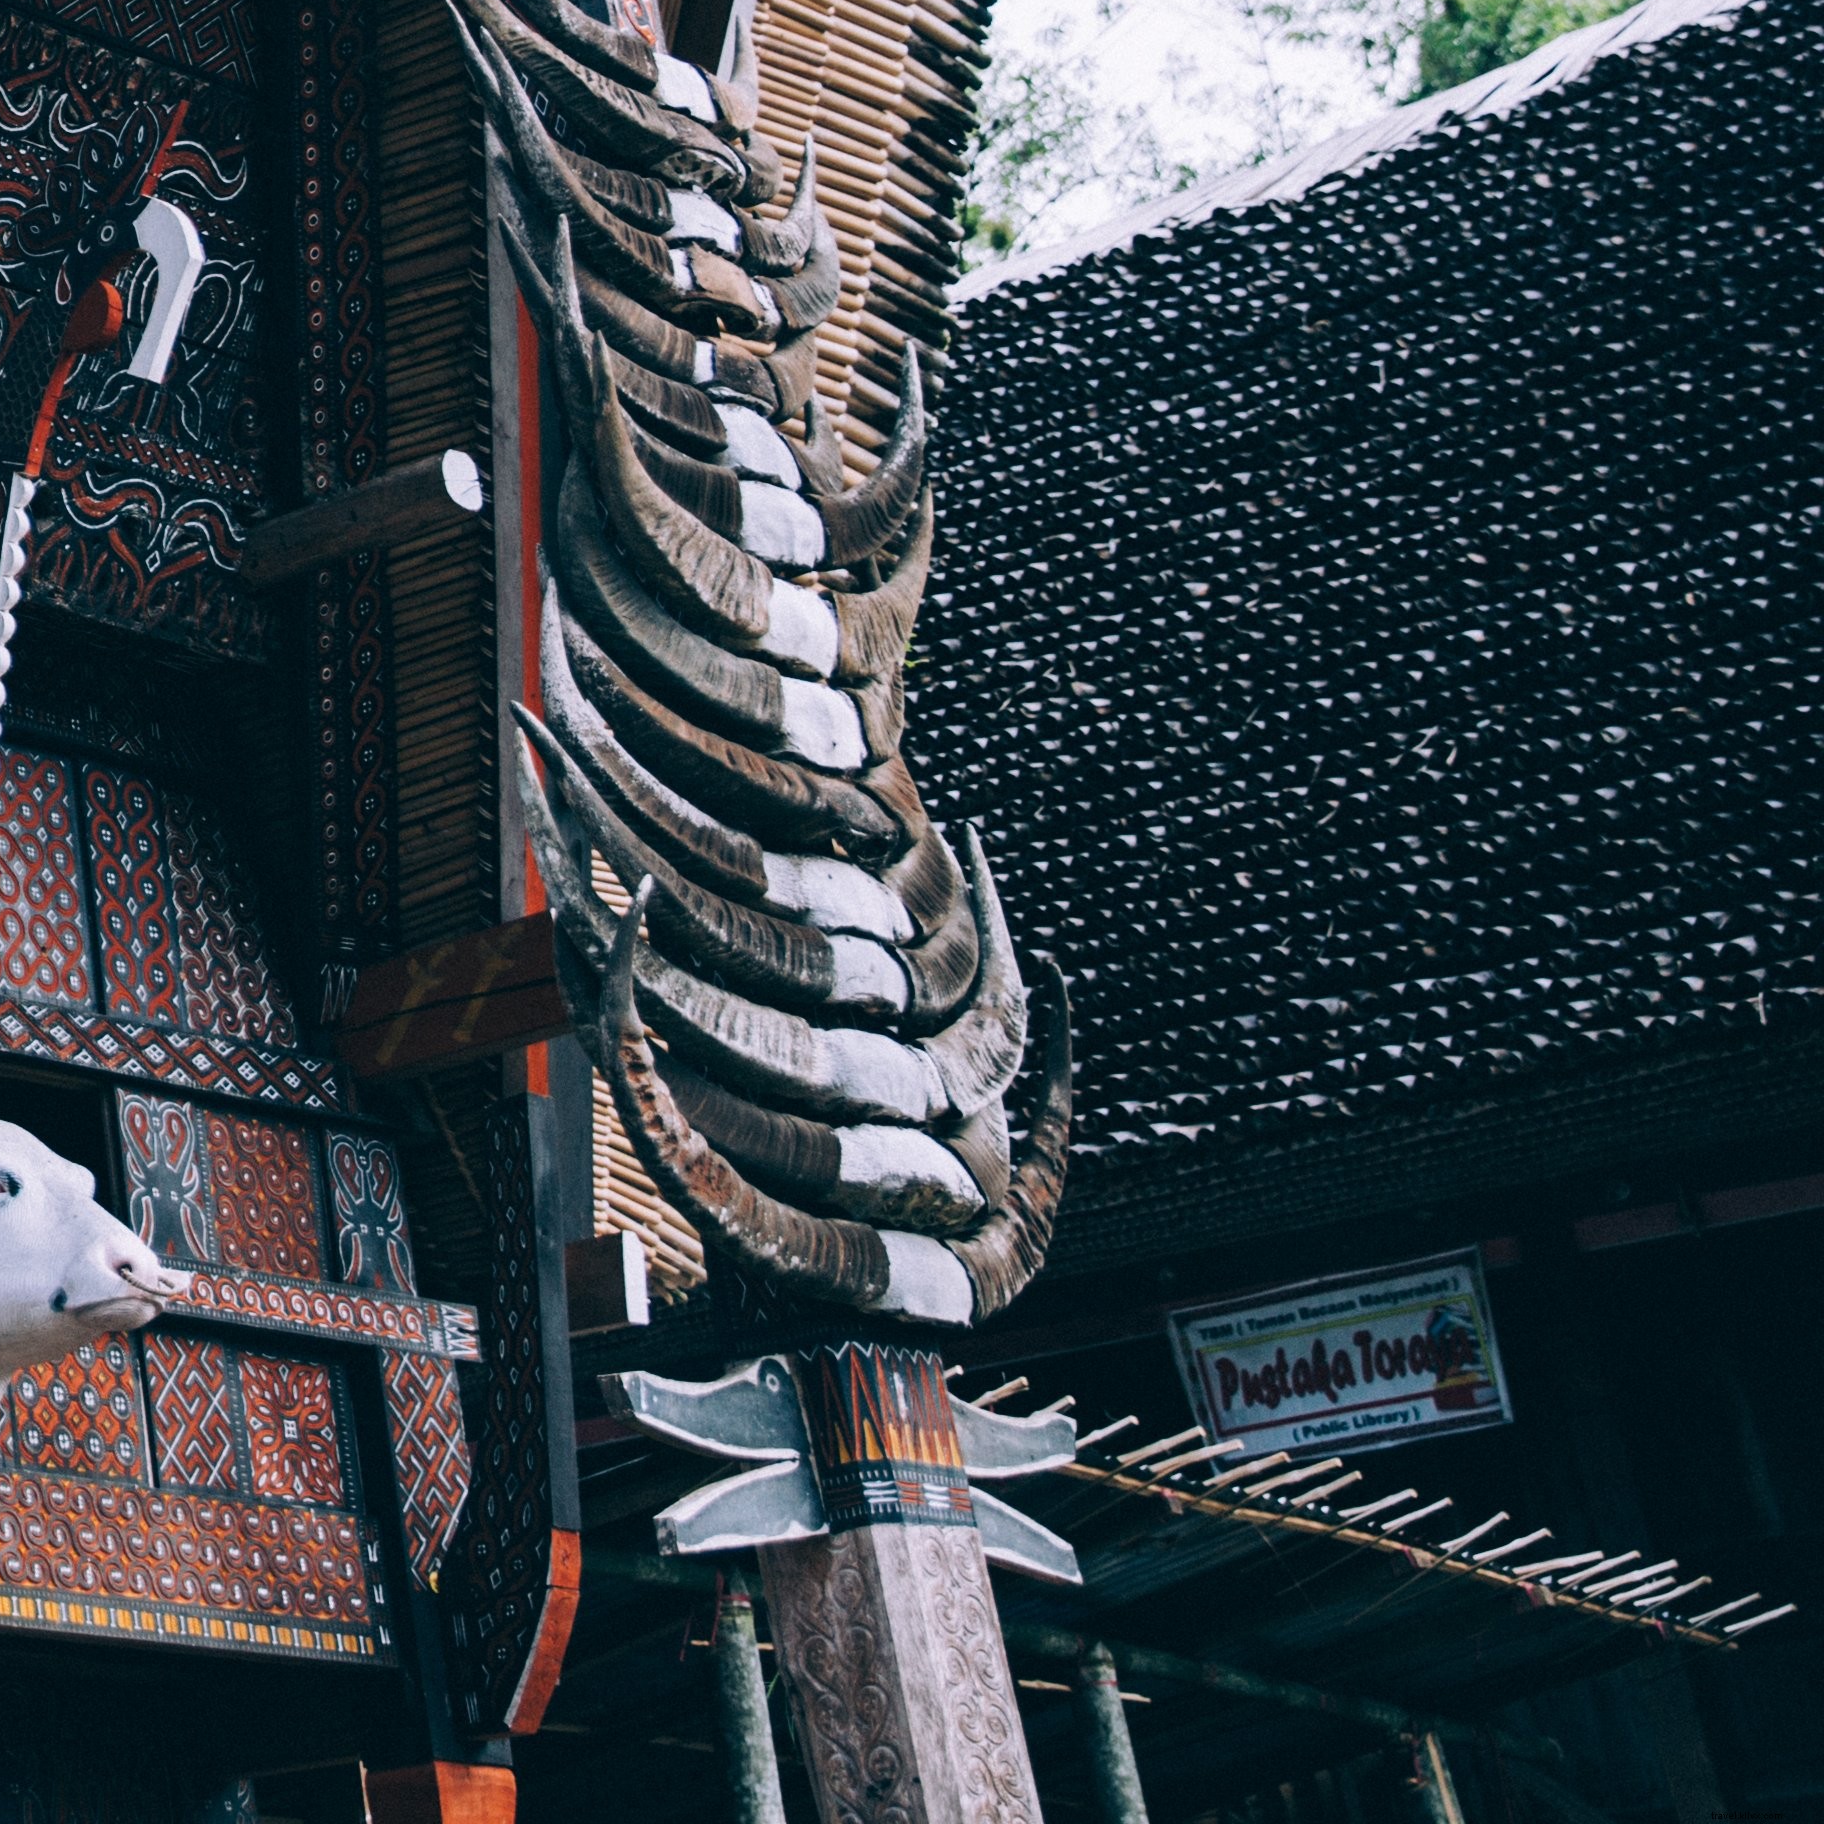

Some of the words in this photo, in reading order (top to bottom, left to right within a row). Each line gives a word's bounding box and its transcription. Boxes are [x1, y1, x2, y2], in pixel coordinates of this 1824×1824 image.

[1245, 1313, 1296, 1331] Taman
[1298, 1300, 1357, 1320] Bacaan
[1214, 1338, 1356, 1412] Pustaka
[1302, 1420, 1350, 1439] Public
[1352, 1410, 1409, 1429] Library
